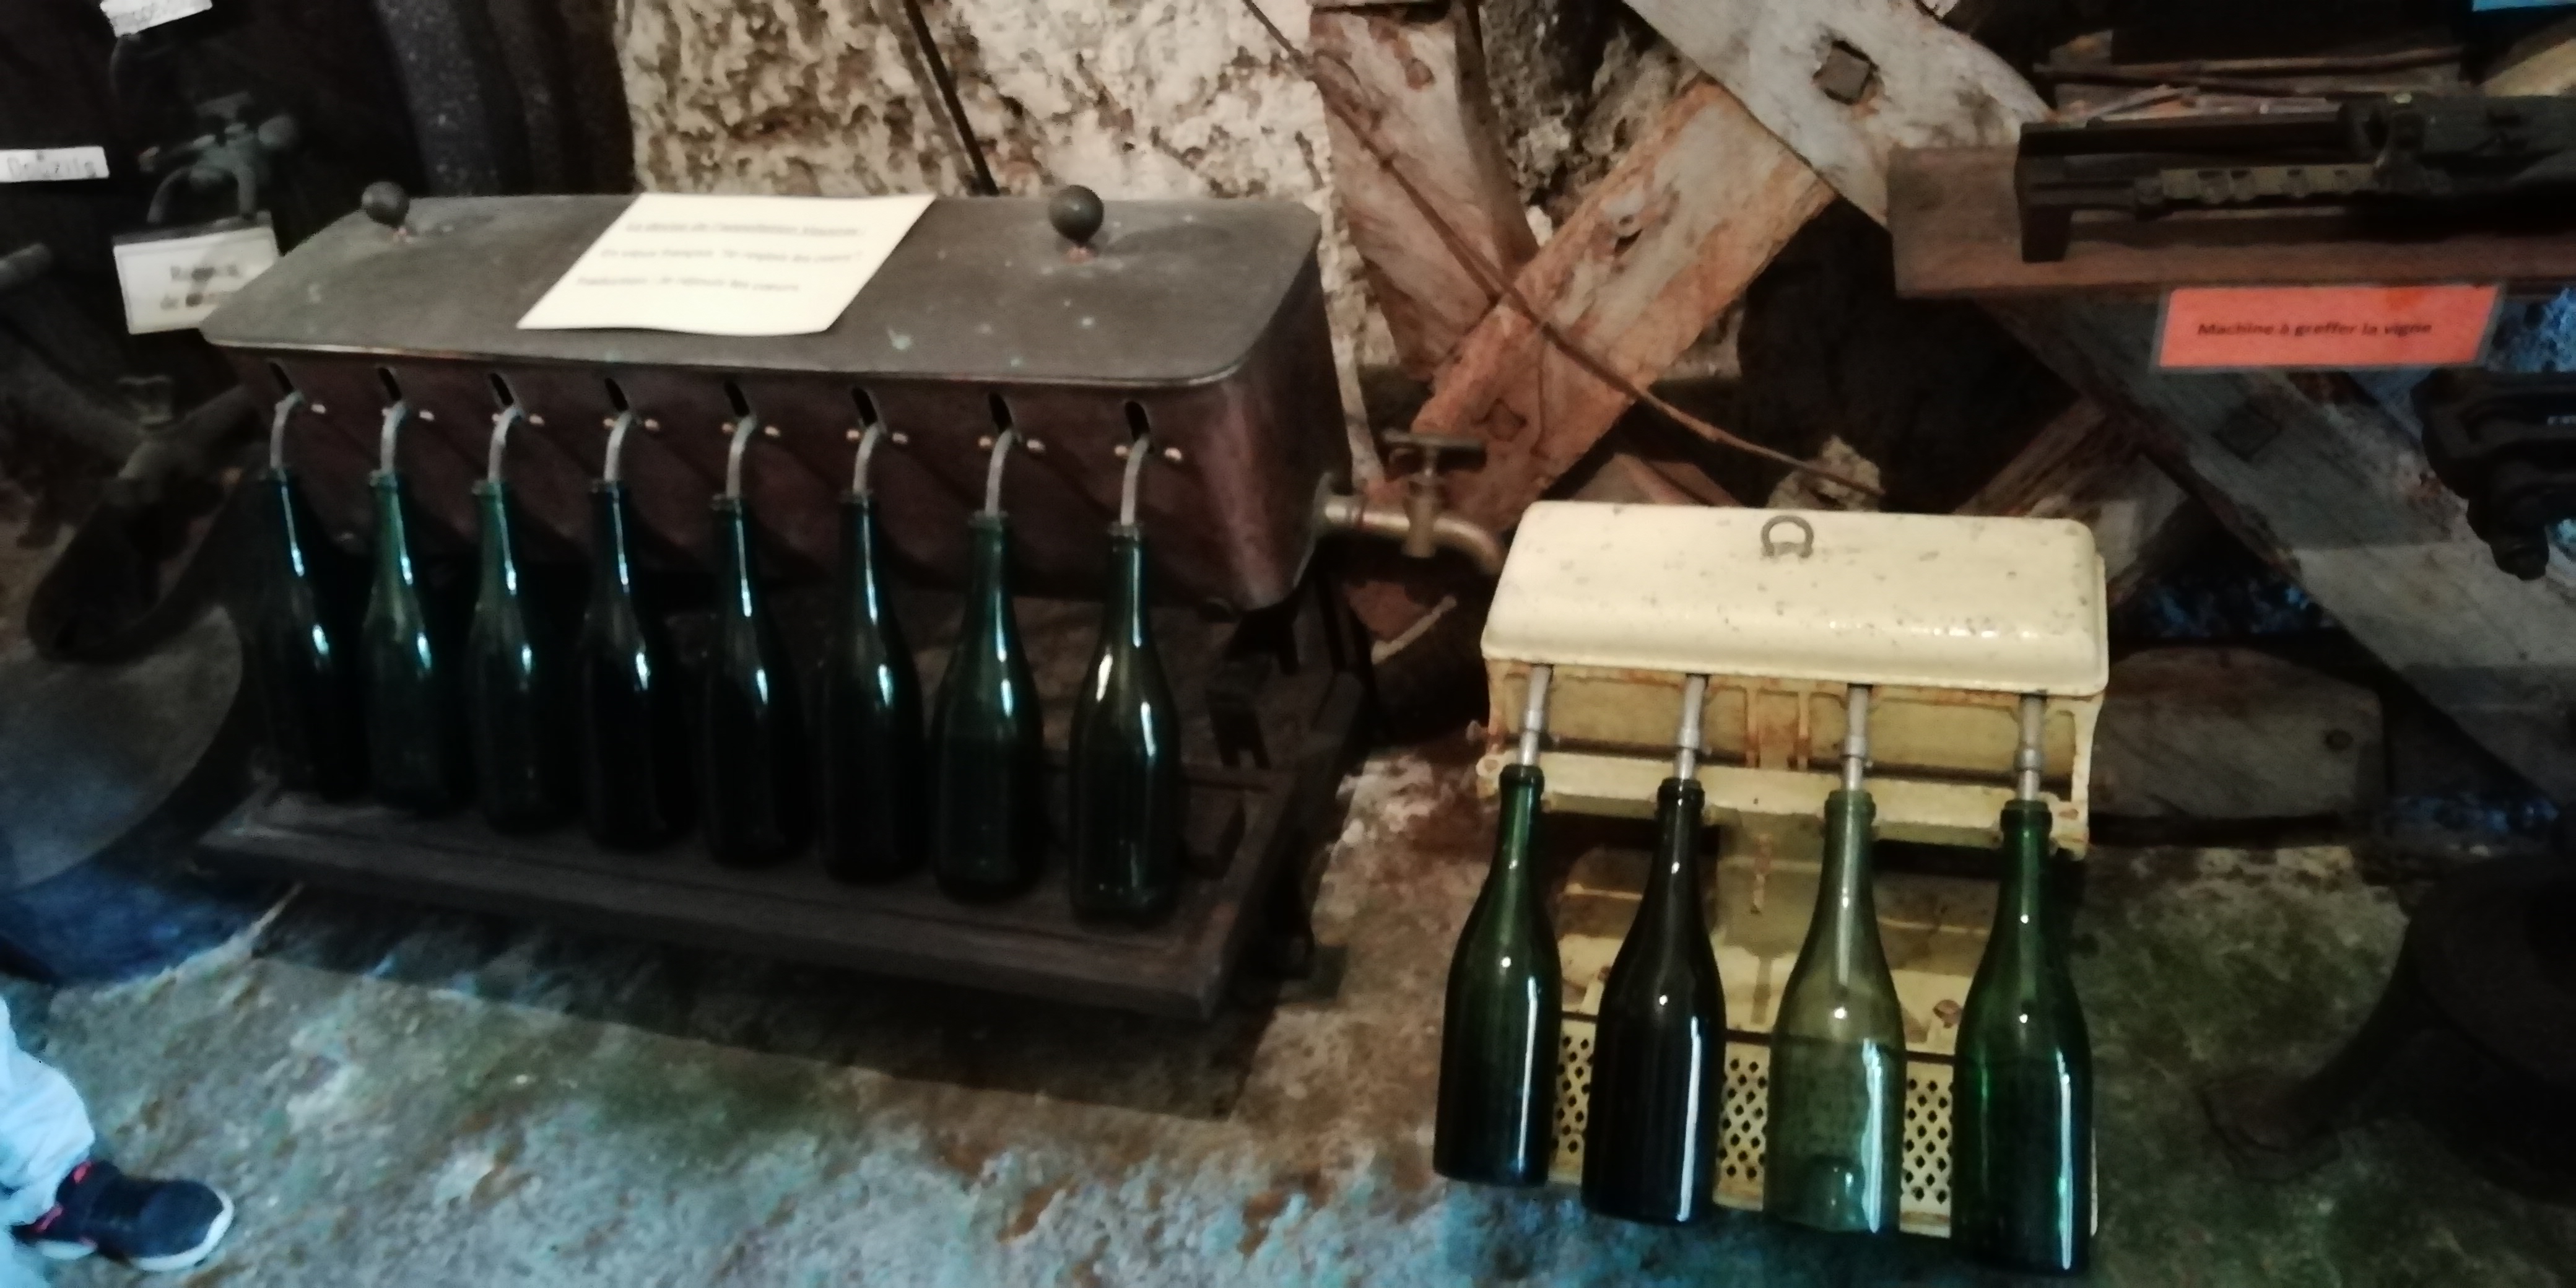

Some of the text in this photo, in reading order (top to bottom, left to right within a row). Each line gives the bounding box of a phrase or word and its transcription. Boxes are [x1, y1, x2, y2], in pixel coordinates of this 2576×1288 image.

[2197, 321, 2433, 337] Machine à greffer la vigne
